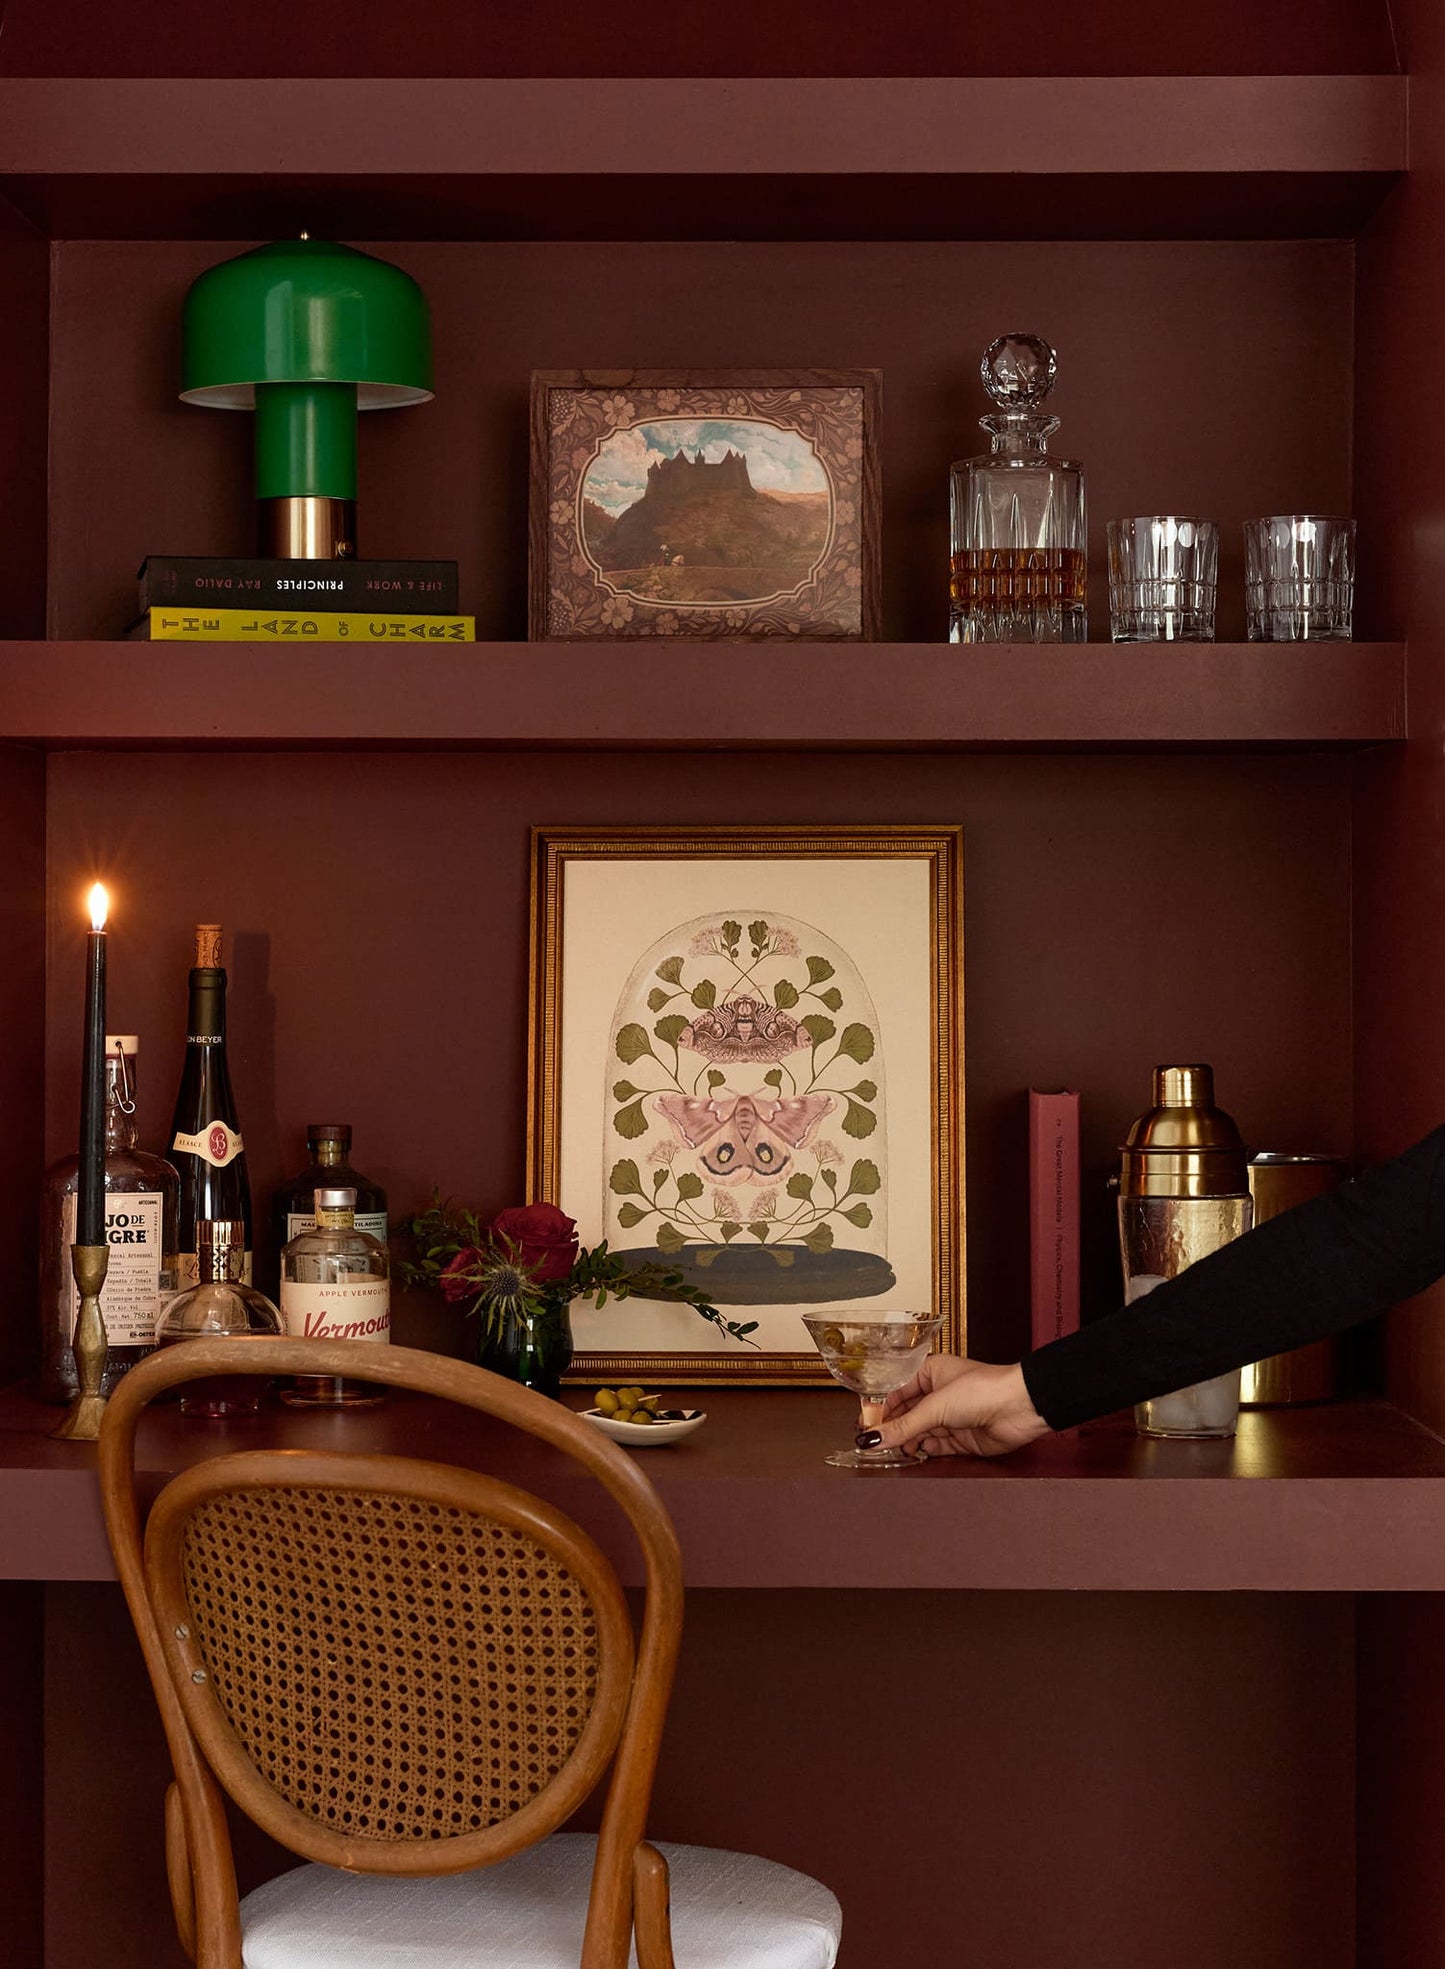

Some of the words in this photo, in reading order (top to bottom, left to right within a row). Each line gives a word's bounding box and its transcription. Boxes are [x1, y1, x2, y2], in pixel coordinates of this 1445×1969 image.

[195, 578, 232, 589] DALIO
[237, 579, 261, 590] RAY
[276, 579, 344, 591] PRINCIPLES
[366, 580, 402, 591] WORK
[419, 581, 442, 591] LIFE
[162, 617, 220, 632] THE
[241, 619, 319, 635] LAND
[338, 620, 349, 637] OF
[369, 622, 465, 641] CHARM
[196, 1035, 222, 1044] BEYER
[105, 1214, 129, 1228] JO
[131, 1214, 146, 1225] DE
[304, 1309, 390, 1340] Vermout
[1055, 1316, 1064, 1338] Biolog
